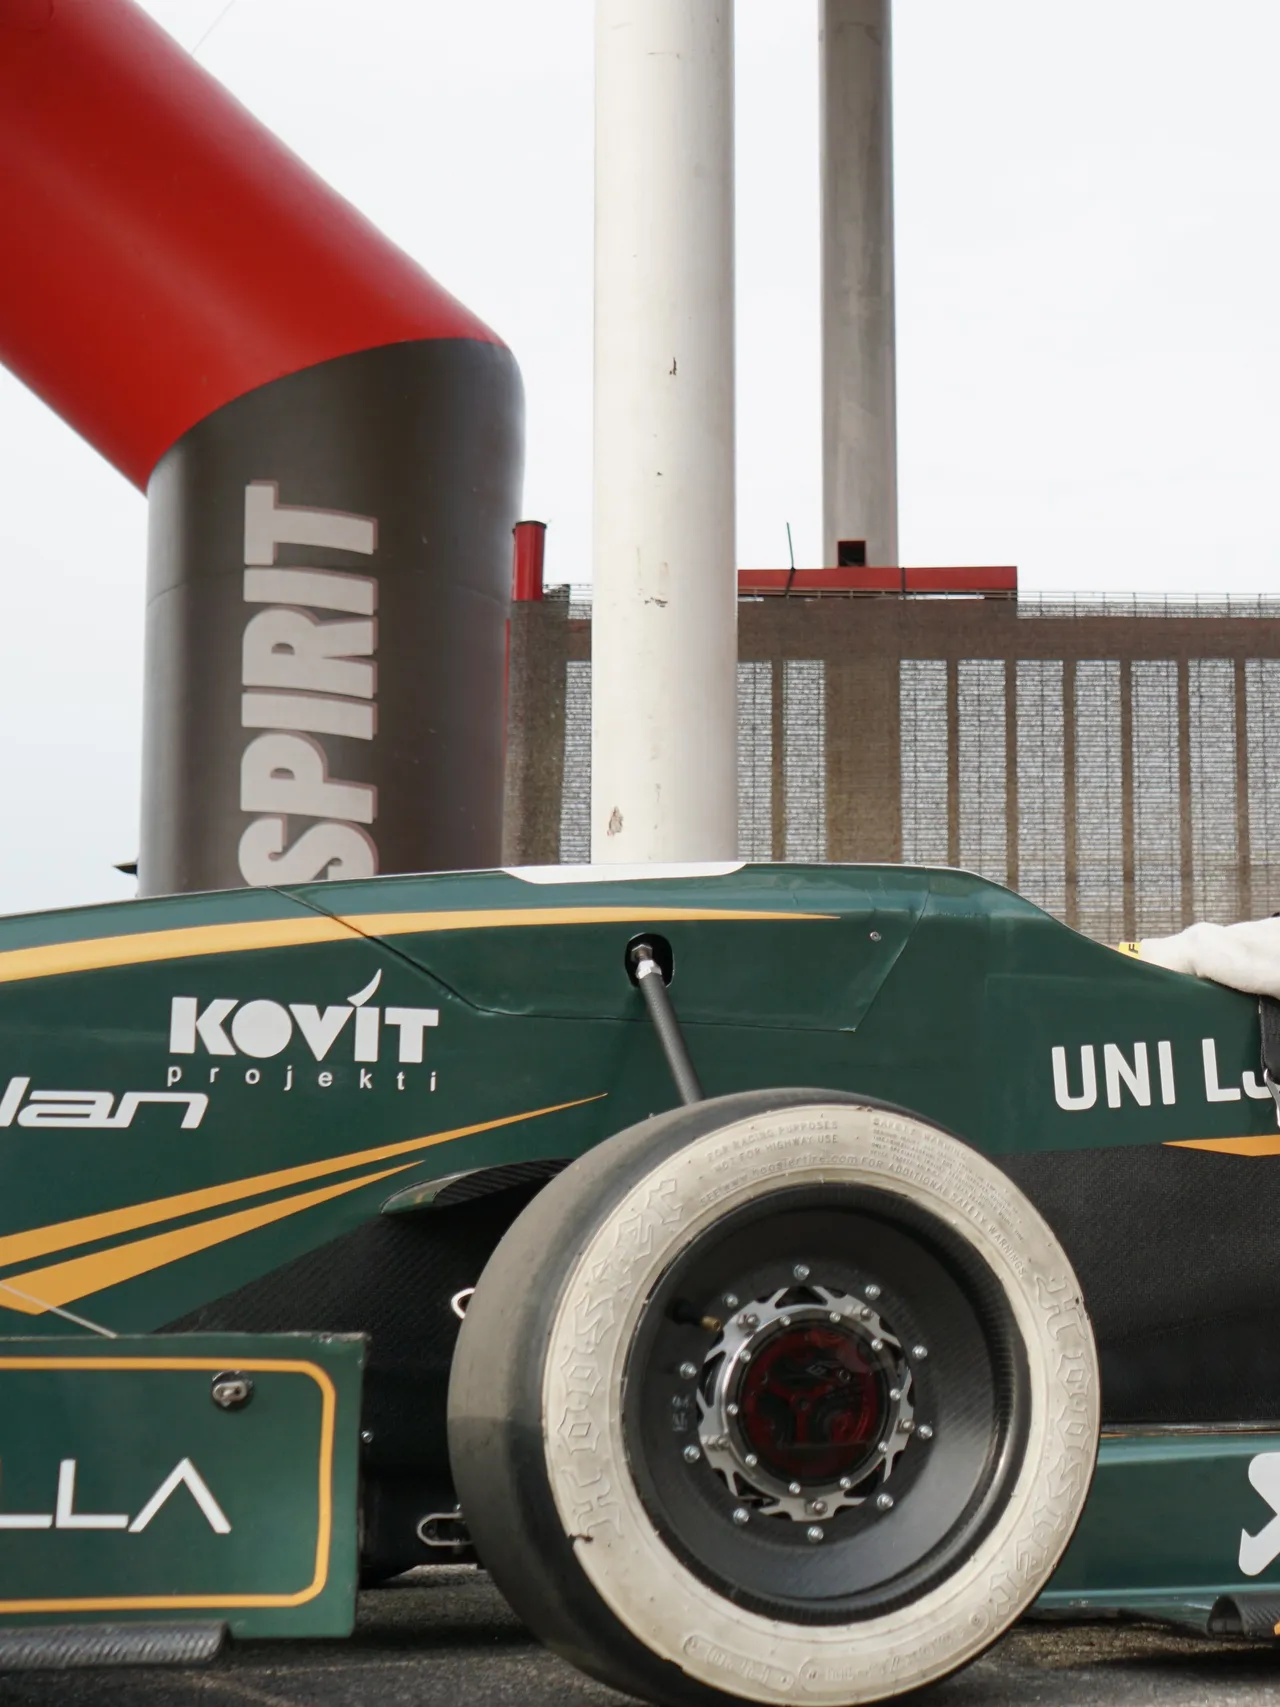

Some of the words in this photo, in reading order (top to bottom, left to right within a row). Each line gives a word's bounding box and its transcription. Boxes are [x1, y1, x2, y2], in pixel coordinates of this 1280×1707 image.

[239, 480, 378, 888] SPIRIT
[167, 1066, 438, 1091] projekti
[1052, 1040, 1177, 1111] UNI
